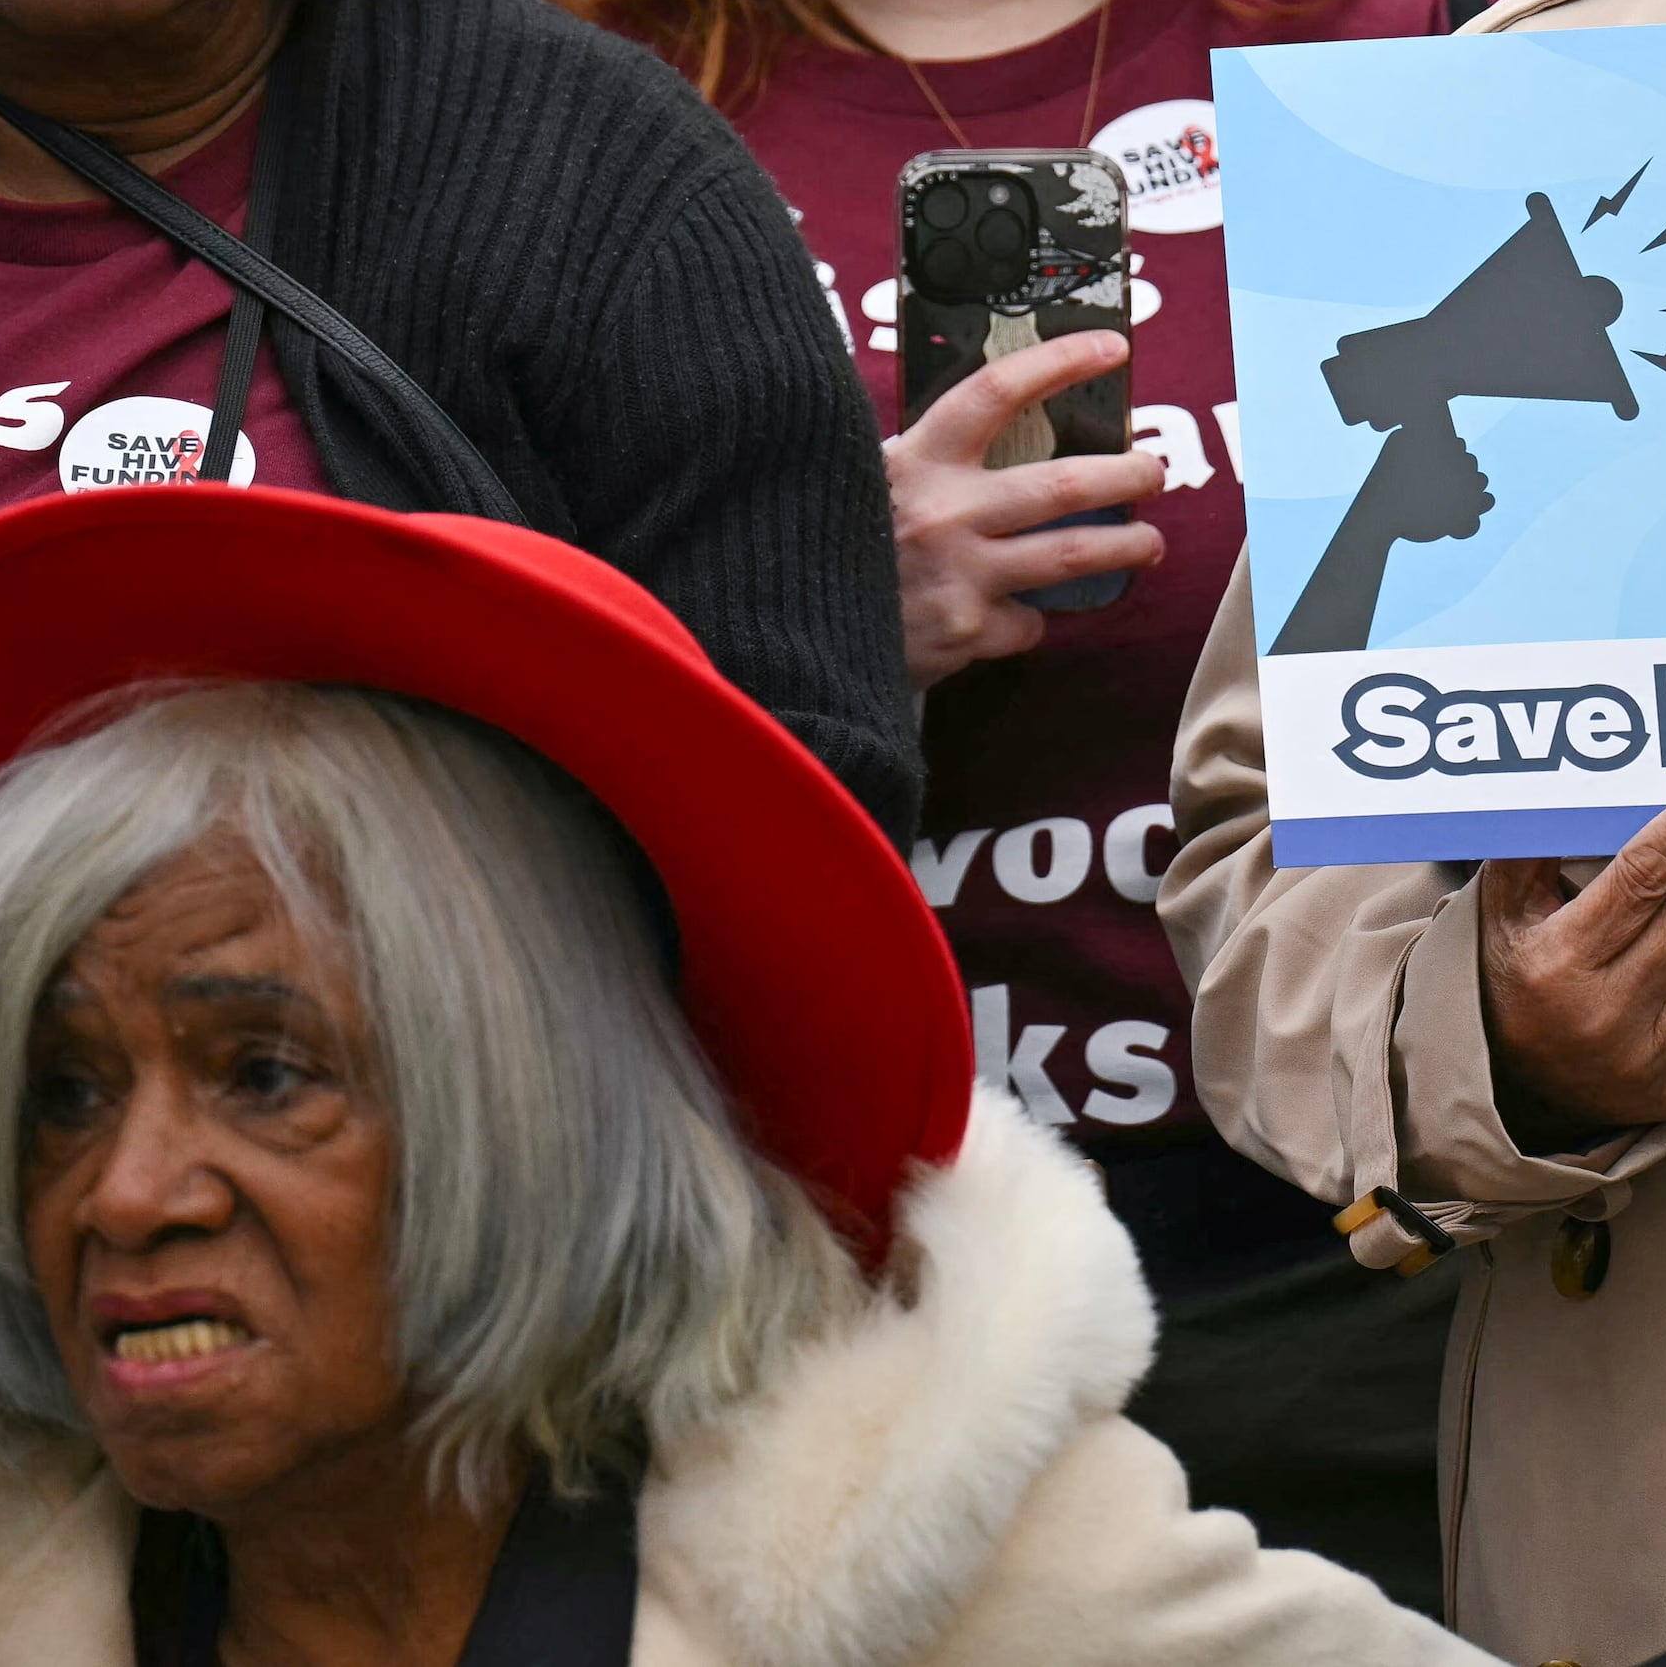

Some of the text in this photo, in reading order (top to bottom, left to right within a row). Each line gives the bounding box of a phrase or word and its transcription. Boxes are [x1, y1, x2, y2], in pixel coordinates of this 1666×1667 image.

[1123, 133, 1207, 163] SAVE
[107, 432, 200, 453] SAVE
[121, 452, 183, 470] HIV
[1336, 673, 1647, 778] Save
